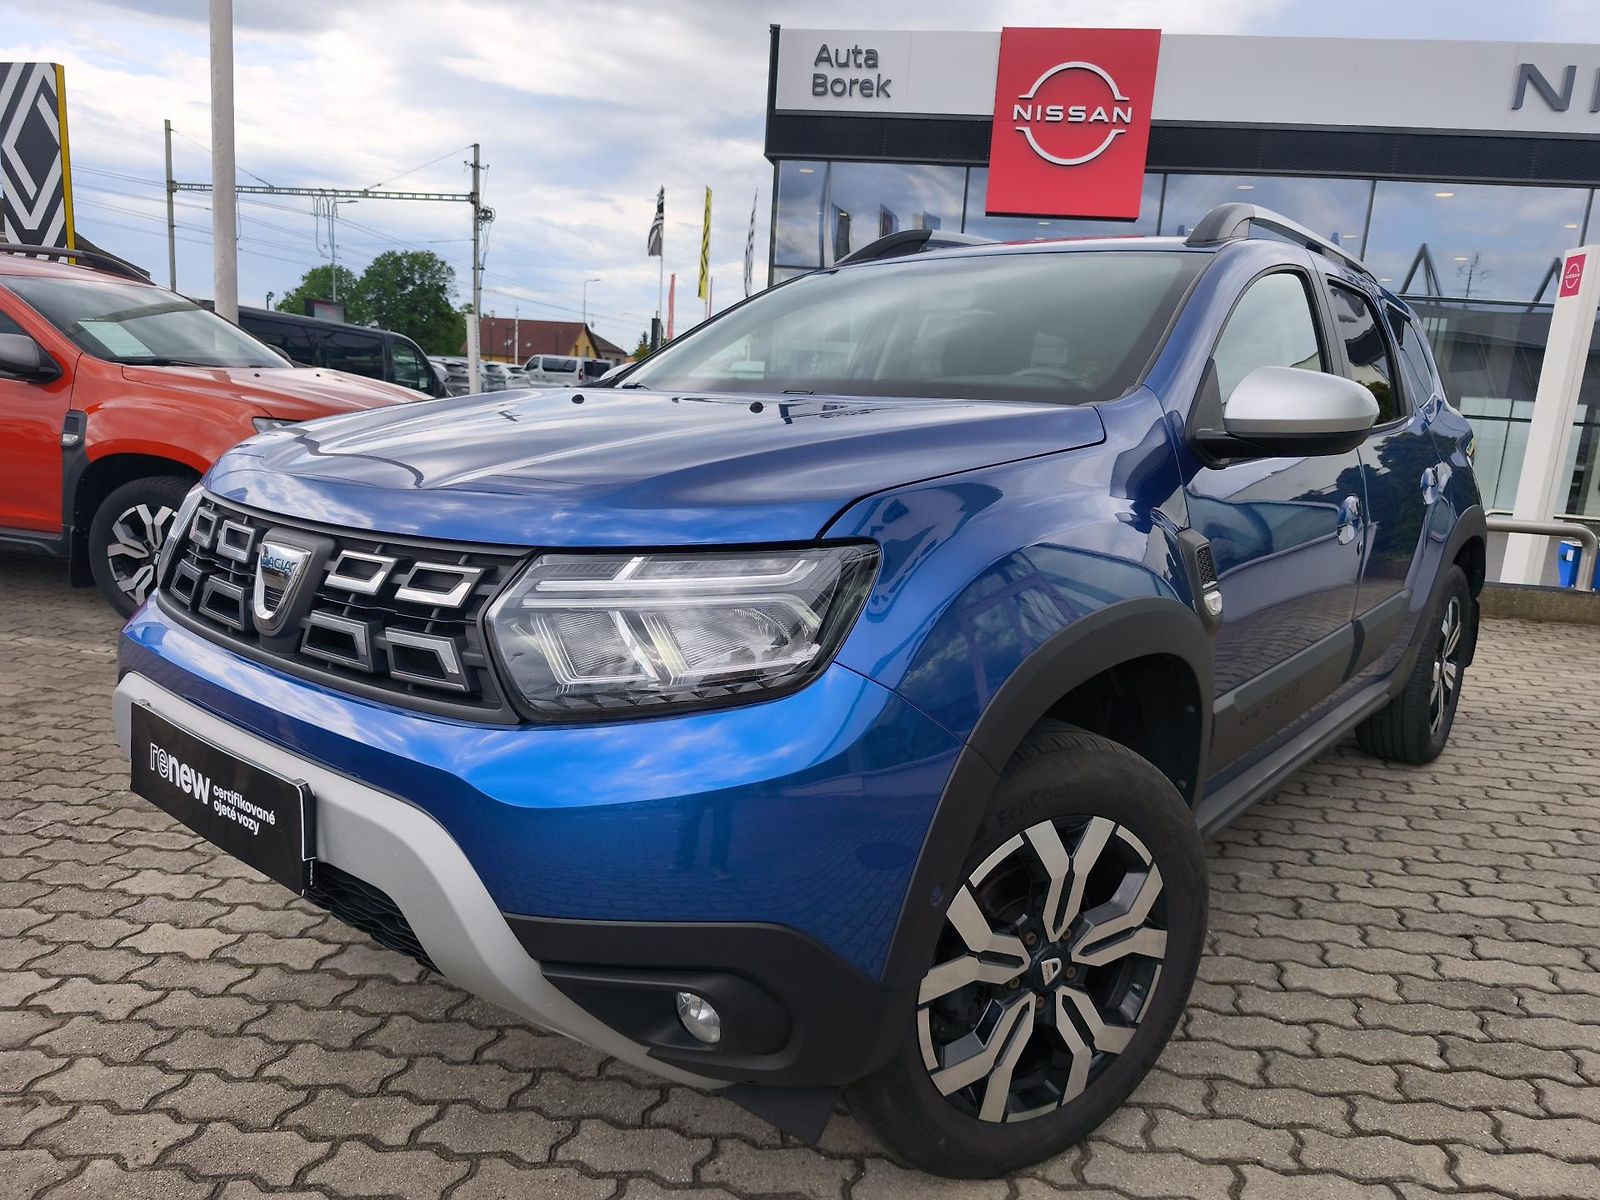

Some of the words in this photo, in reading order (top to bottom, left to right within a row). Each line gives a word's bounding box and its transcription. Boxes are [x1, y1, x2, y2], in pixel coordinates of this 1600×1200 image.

[813, 43, 879, 69] Auta
[811, 73, 892, 99] Borek
[1012, 103, 1133, 124] NISSAN
[150, 742, 211, 805] renew
[213, 785, 276, 826] certifikované
[213, 799, 237, 822] ojeté
[237, 811, 260, 836] vozy
